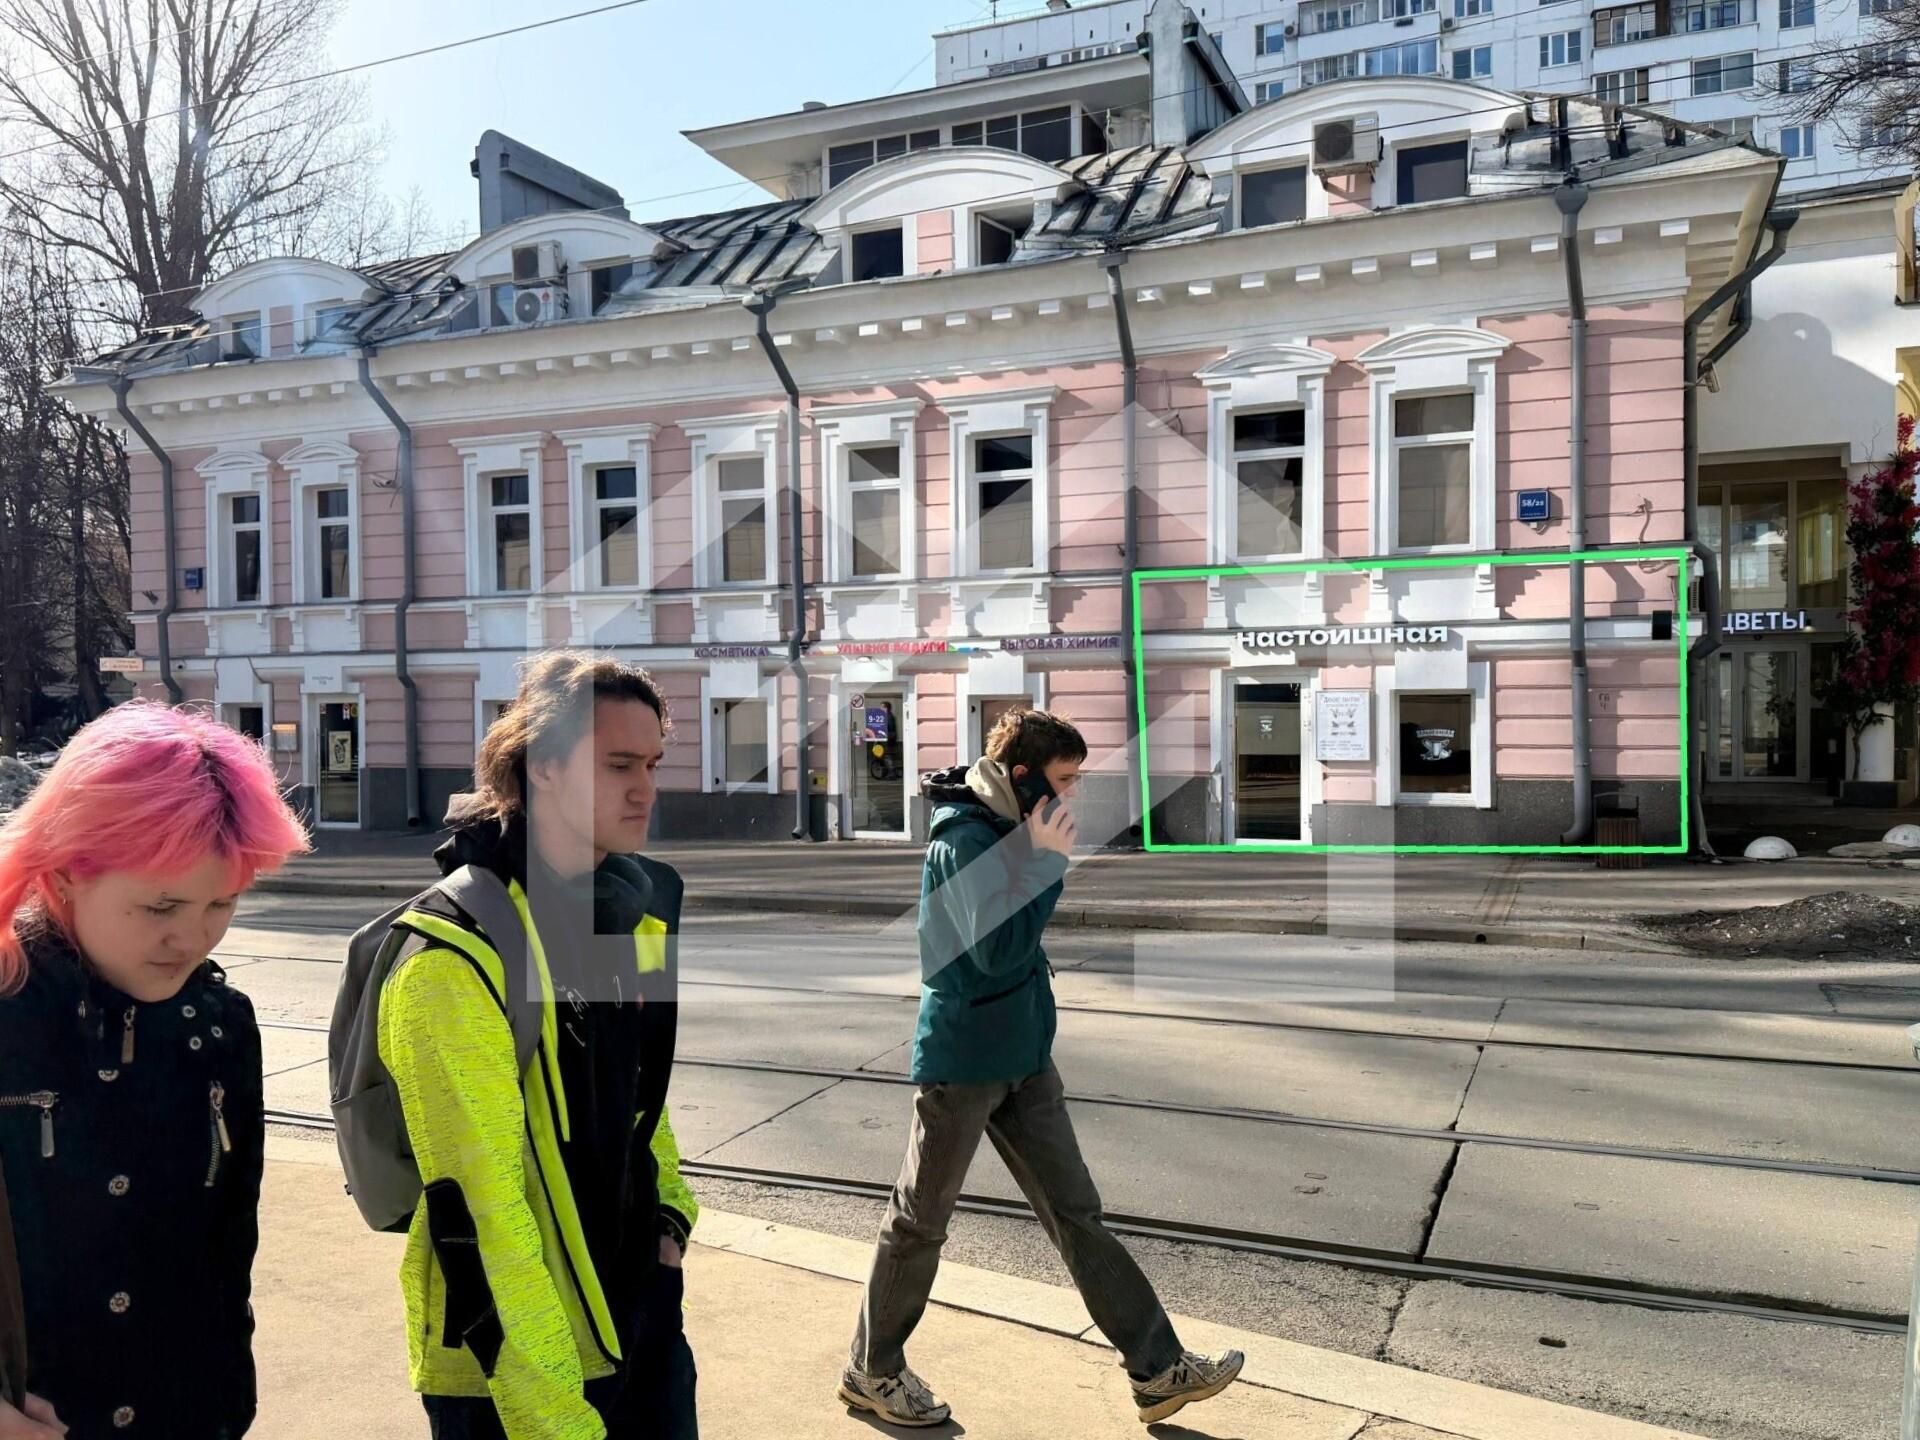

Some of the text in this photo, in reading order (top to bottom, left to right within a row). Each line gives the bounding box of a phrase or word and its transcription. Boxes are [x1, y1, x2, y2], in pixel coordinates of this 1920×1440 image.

[1722, 611, 1805, 634] ЦВЕТЫ
[1000, 636, 1119, 650] БЫТОВАЯ ХИМИЯ
[694, 646, 767, 658] КОСМЕТИКА
